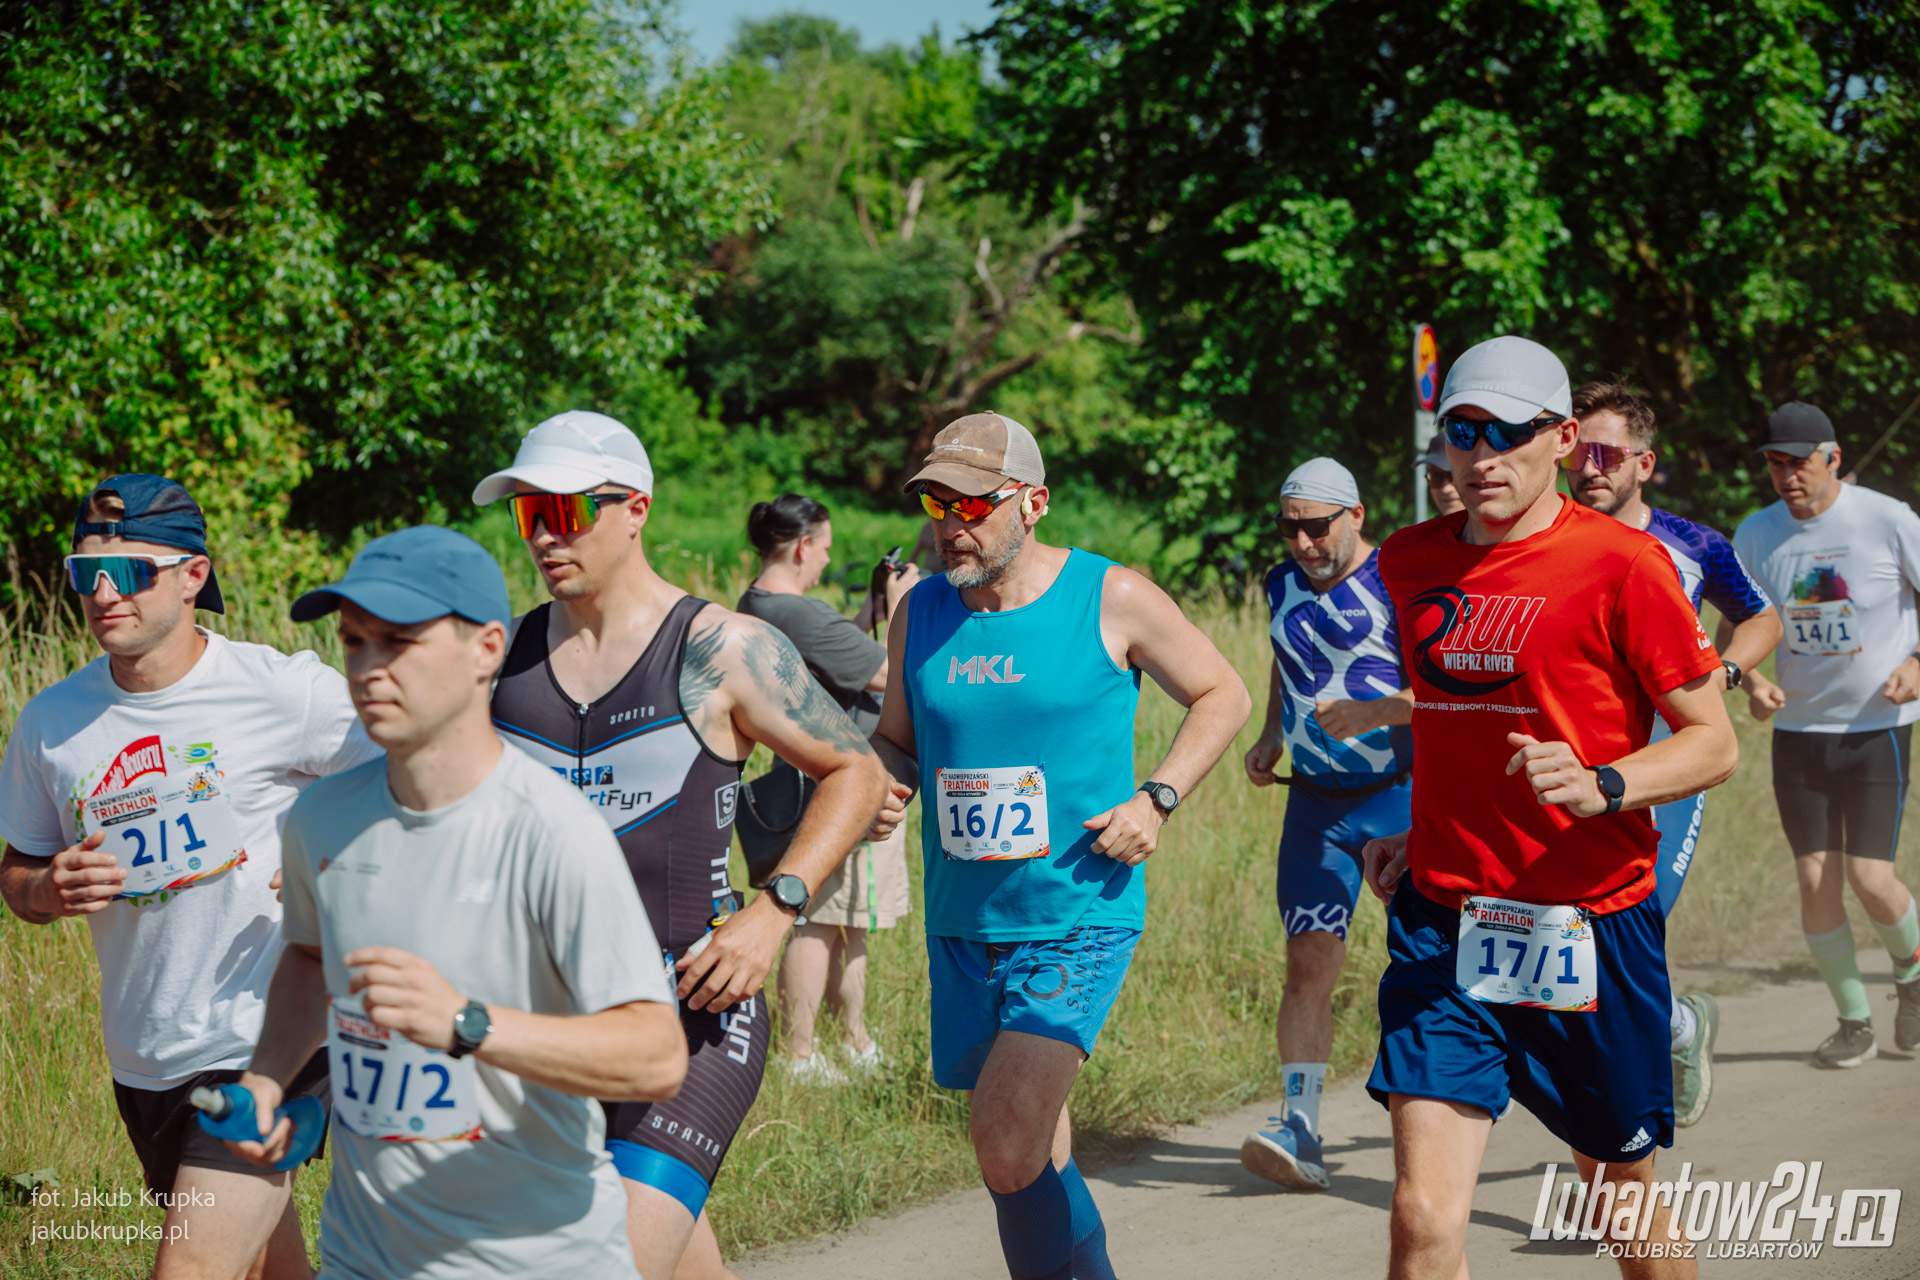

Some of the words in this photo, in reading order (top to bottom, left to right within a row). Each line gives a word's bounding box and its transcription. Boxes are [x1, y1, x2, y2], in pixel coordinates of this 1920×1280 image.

[1795, 621, 1851, 644] 14/1
[947, 654, 1026, 684] MKL
[1443, 653, 1482, 670] WIEPRZ
[1484, 654, 1515, 673] RIVER
[1449, 702, 1486, 711] TERENOWY
[943, 780, 989, 790] TRIATHLON
[92, 794, 158, 821] TRIATHLON
[949, 802, 1035, 839] 16/2
[122, 812, 207, 868] 2/1
[1473, 909, 1534, 929] TRIATHLON
[1478, 937, 1580, 984] 17/1
[342, 1052, 455, 1111] 17/2
[652, 1115, 720, 1156] SCATTO
